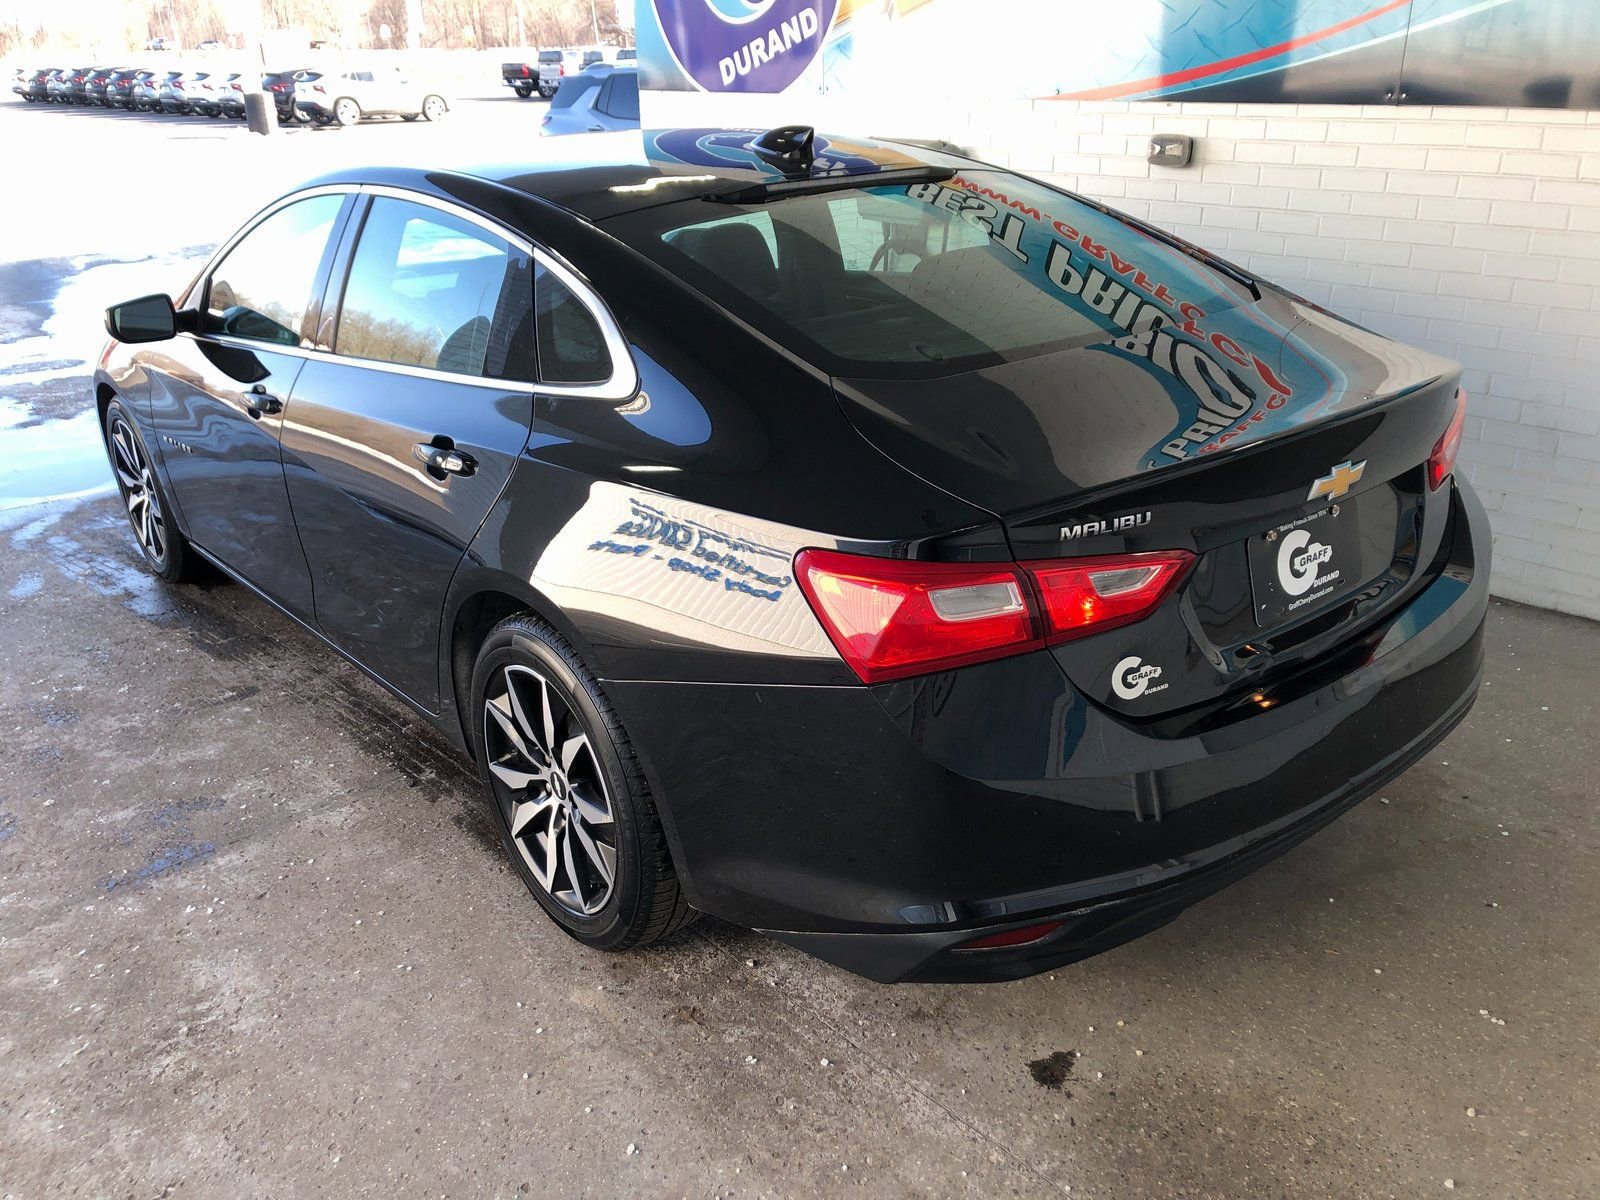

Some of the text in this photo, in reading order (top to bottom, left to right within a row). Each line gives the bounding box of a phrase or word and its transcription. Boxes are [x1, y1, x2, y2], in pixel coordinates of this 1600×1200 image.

[718, 7, 819, 86] DURAND
[1059, 511, 1152, 541] MALIBU
[1300, 547, 1329, 567] GRAFF
[1313, 570, 1340, 588] DURAND
[1131, 667, 1159, 682] GRAFF
[1144, 683, 1169, 696] DURAND
